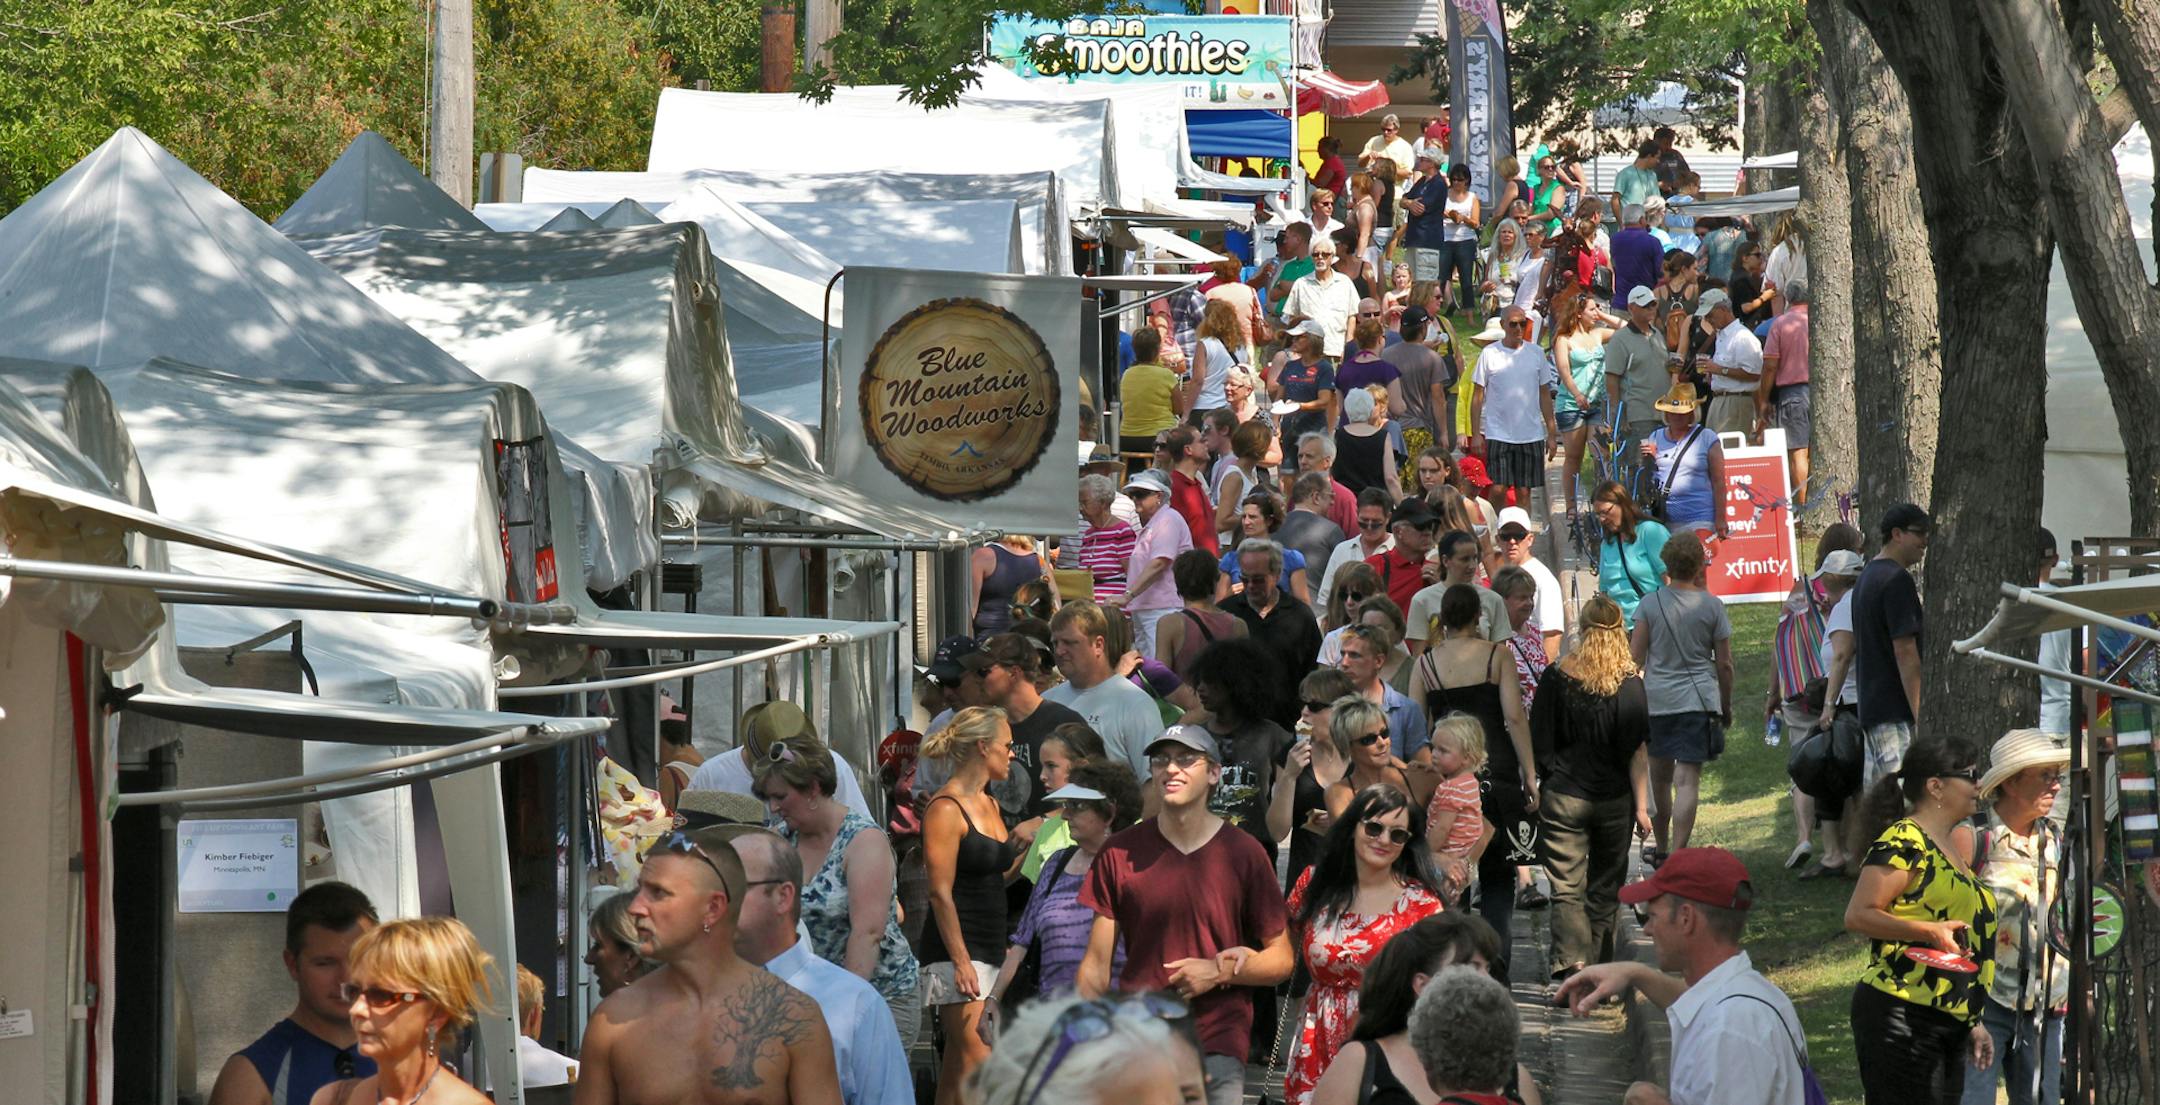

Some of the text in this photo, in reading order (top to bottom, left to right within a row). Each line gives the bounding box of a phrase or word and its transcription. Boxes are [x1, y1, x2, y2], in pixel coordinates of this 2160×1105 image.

[1068, 18, 1146, 37] BAJA
[916, 345, 988, 377] Blue
[886, 369, 1031, 408] Mountain
[880, 391, 1049, 439] Woodworks
[1729, 474, 1752, 485] me
[1728, 516, 1757, 534] ney!
[1725, 557, 1788, 579] xfinity
[882, 741, 920, 758] xfinit
[205, 852, 275, 863] Kimber Fiebiger
